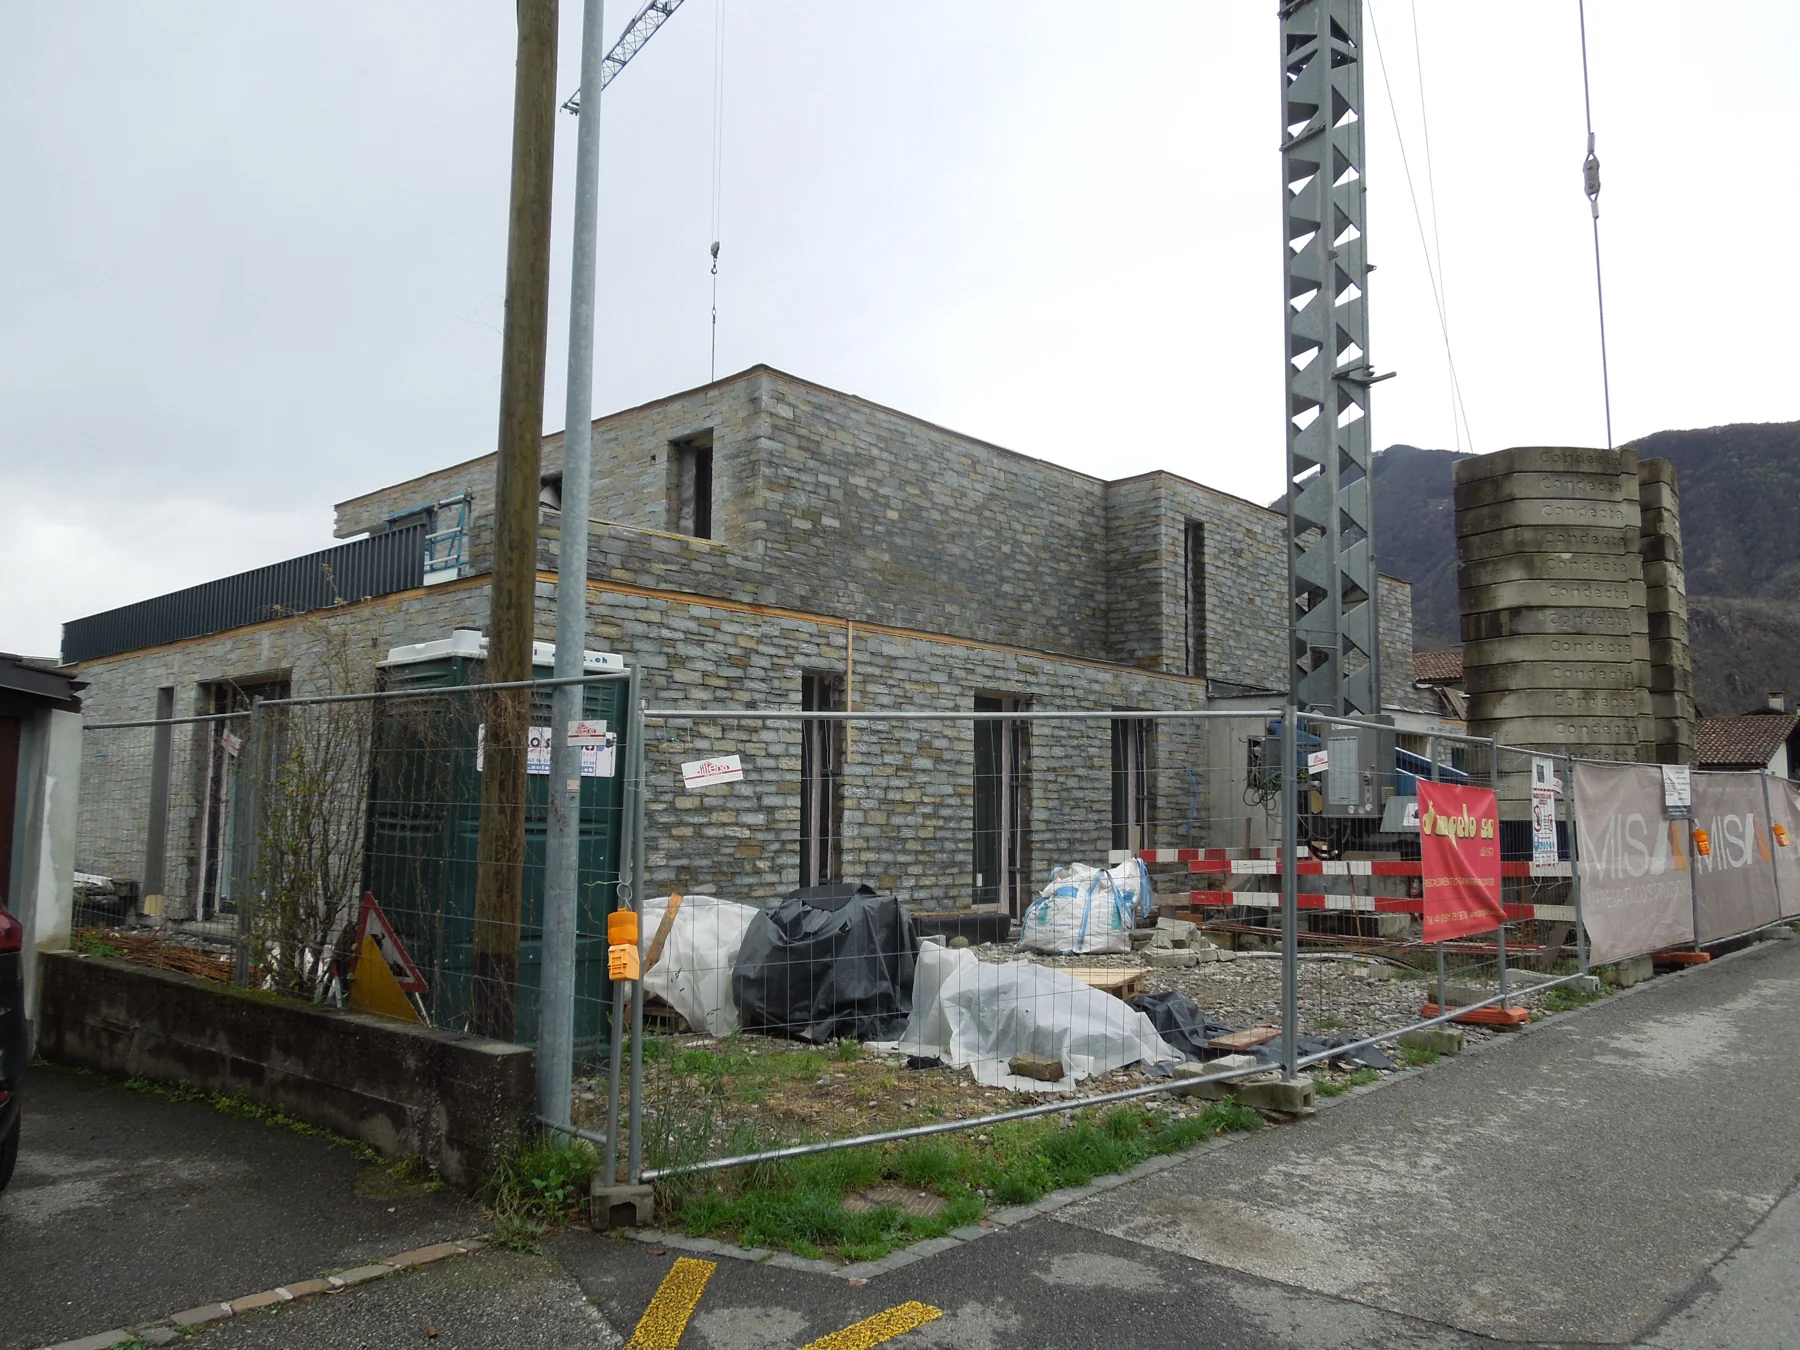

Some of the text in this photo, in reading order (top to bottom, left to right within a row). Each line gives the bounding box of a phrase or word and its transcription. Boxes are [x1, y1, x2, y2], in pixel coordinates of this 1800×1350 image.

[1540, 476, 1622, 492] Condecta
[1542, 504, 1624, 519] Condecta
[1544, 532, 1625, 546] Condecta
[1546, 558, 1628, 573] Condecta
[1548, 585, 1629, 599] Condecta
[1549, 612, 1632, 627] Condecta
[1551, 639, 1632, 653] Condecta
[1552, 667, 1634, 680] Condecta
[1554, 694, 1636, 707] Condecta
[1555, 722, 1638, 735] Condecta
